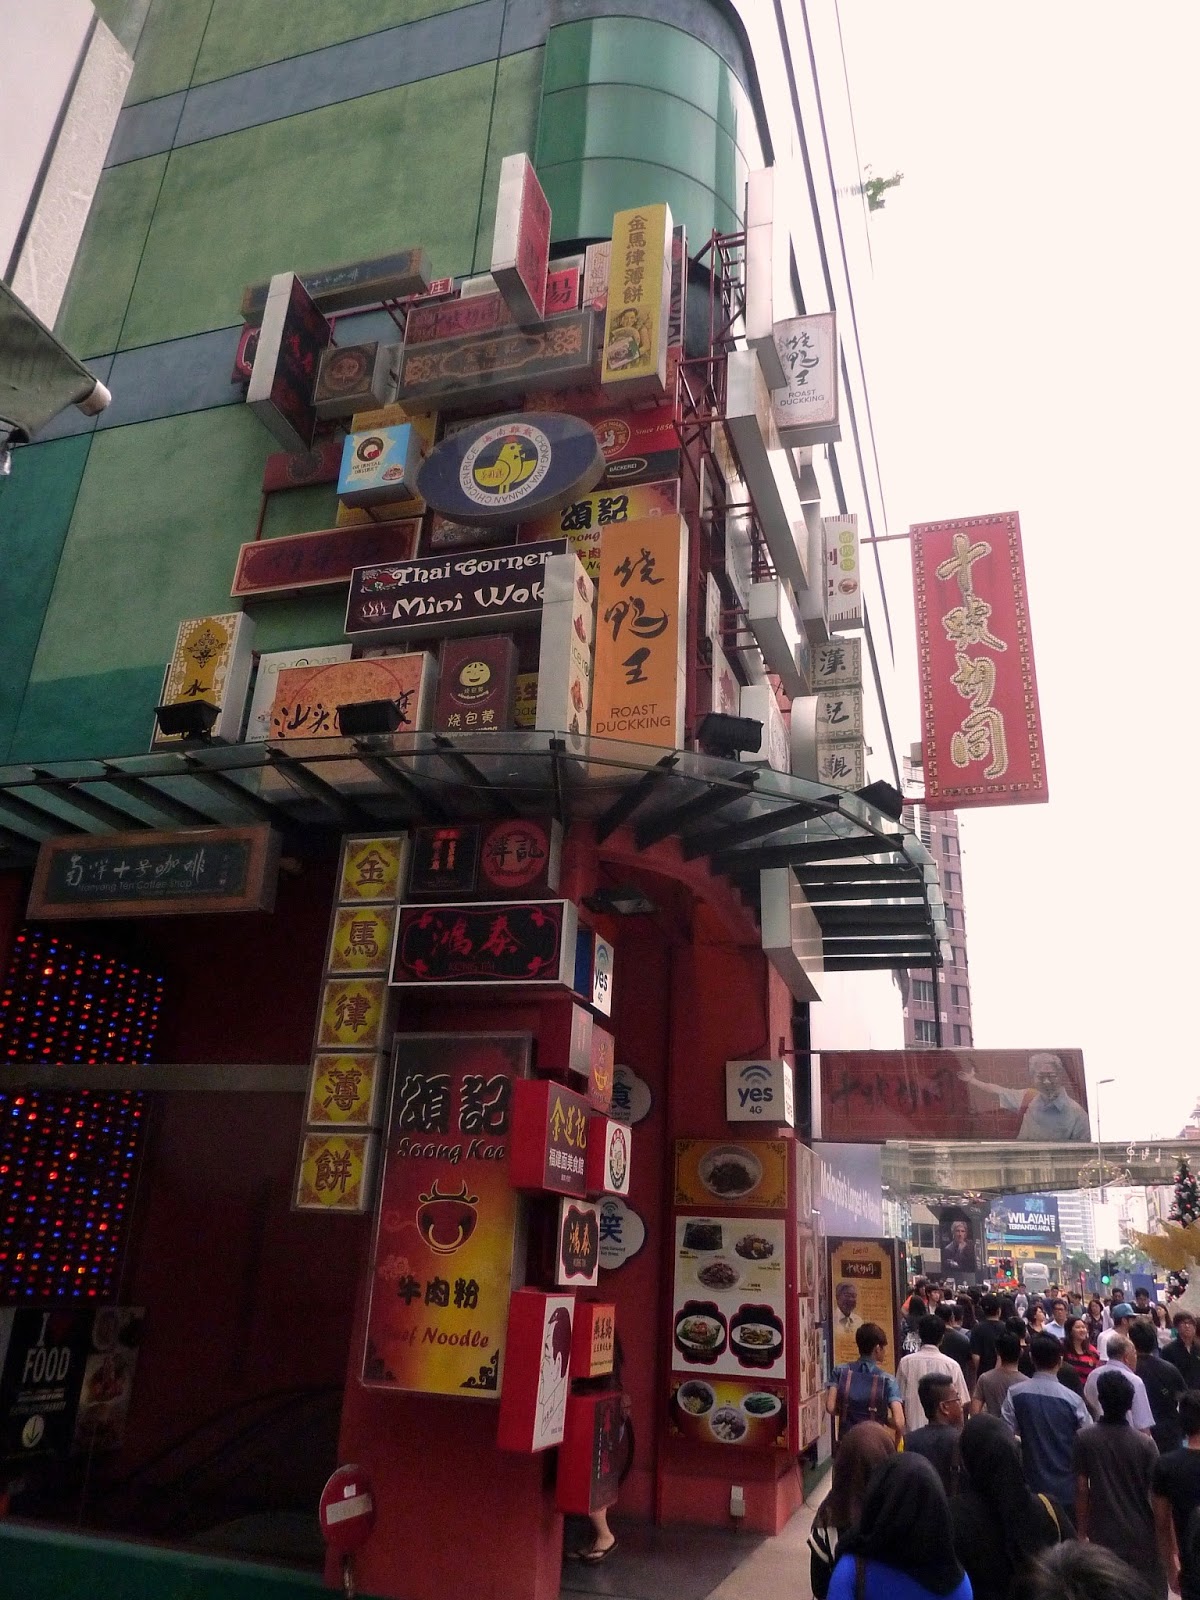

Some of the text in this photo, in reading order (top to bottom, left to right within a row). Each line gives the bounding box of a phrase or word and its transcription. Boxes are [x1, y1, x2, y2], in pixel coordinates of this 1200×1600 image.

[780, 394, 825, 407] DUCKKING
[788, 389, 817, 399] ROAST
[635, 423, 674, 436] Since 1856
[534, 434, 550, 462] CHONG
[462, 447, 480, 471] RICE
[529, 464, 547, 483] HWA
[463, 472, 492, 504] CHICKEN
[494, 484, 532, 504] HAINAN
[392, 562, 451, 587] Thai
[454, 550, 553, 577] Corner
[392, 581, 546, 620] Mini Wok
[610, 702, 658, 719] ROAST
[596, 715, 672, 734] DUCKKING
[119, 879, 136, 891] Ten
[136, 879, 168, 891] Coffee
[169, 878, 193, 890] Shop
[594, 969, 608, 992] yes
[597, 992, 604, 1004] 4G
[737, 1086, 774, 1108] yes
[749, 1105, 763, 1115] 4G
[397, 1137, 506, 1165] Soong Kee
[599, 1212, 624, 1244] 笑
[1007, 1211, 1051, 1226] WILAYAH
[397, 1274, 480, 1310] 牛肉粉
[421, 1327, 489, 1348] Noodle
[22, 1347, 71, 1384] FOOD
